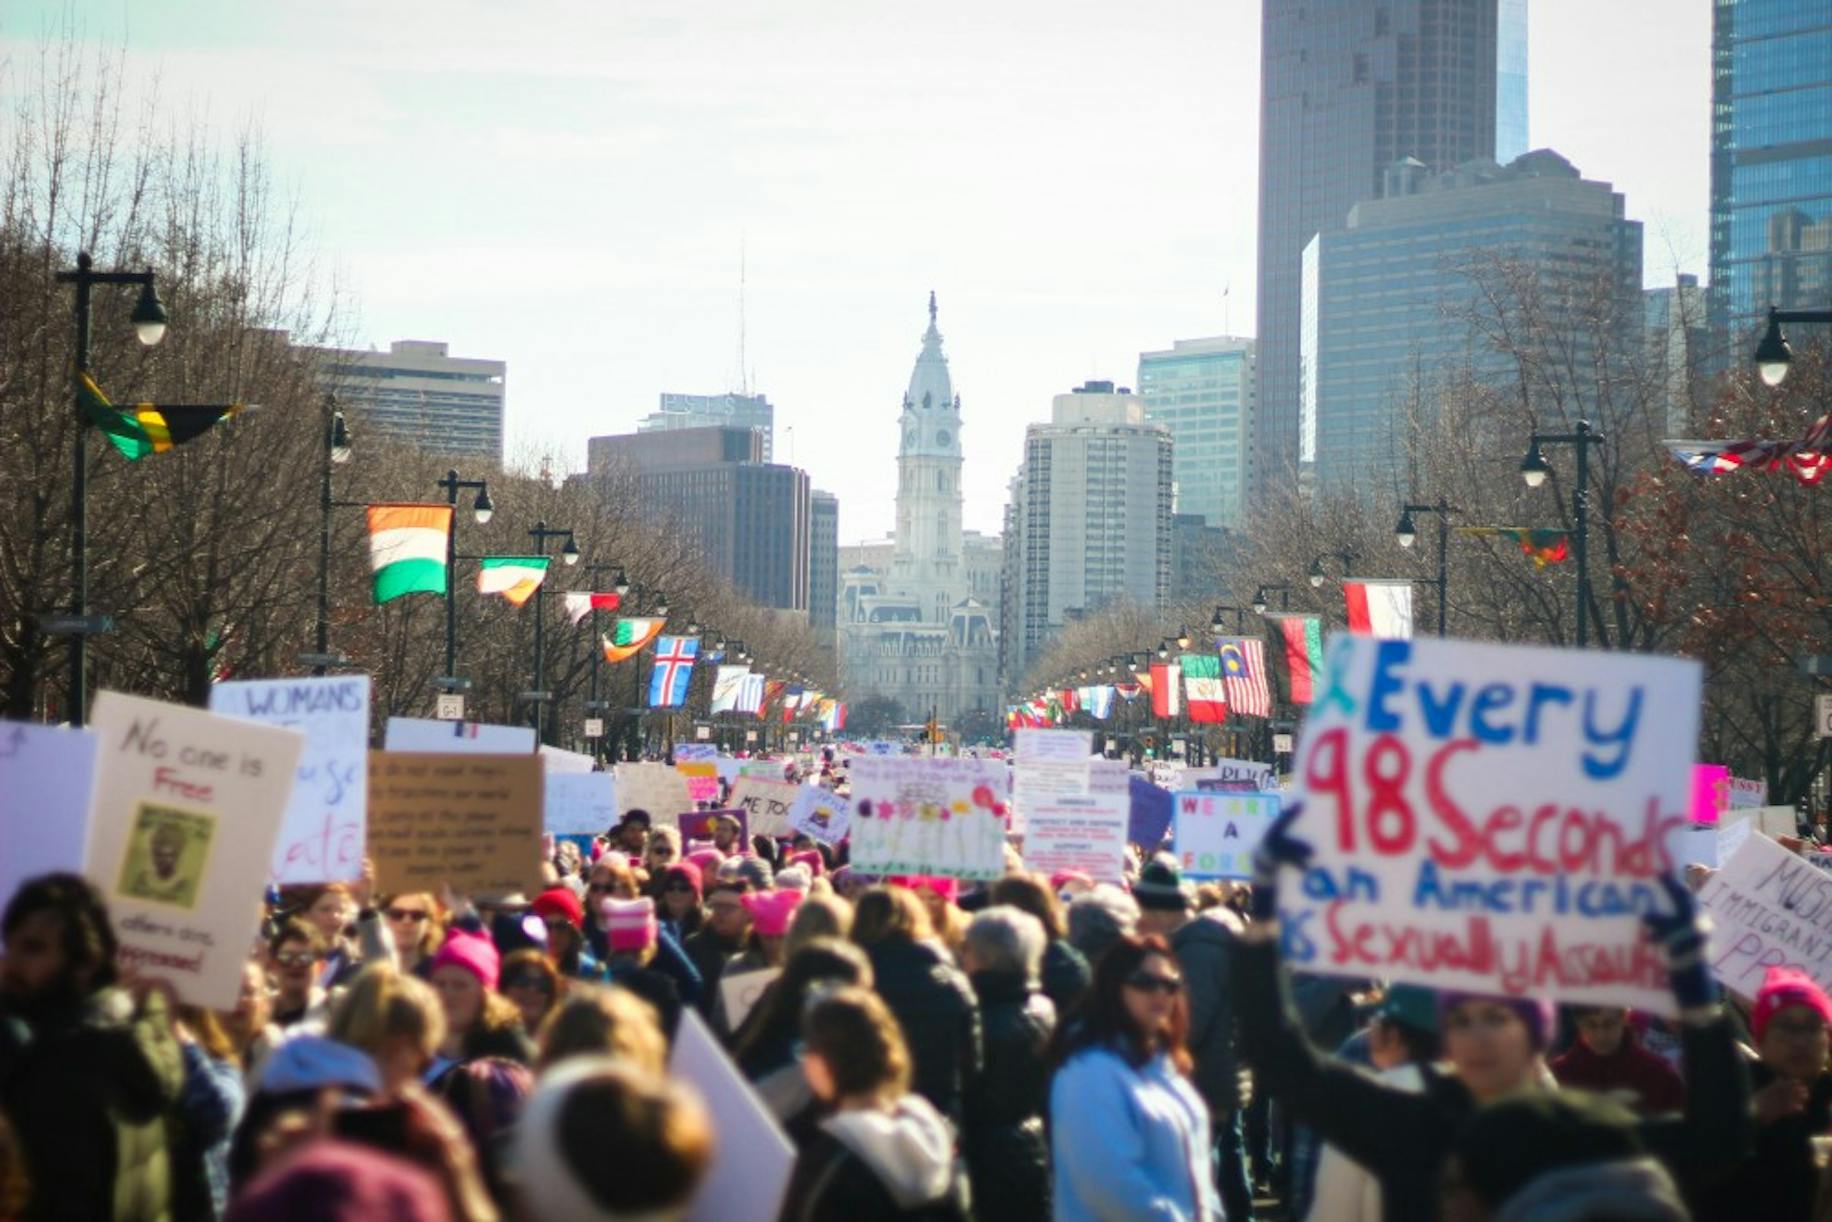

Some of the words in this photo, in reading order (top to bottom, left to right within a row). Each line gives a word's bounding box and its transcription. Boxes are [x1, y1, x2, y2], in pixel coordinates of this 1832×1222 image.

[1364, 638, 1645, 781] Every
[120, 716, 168, 759] No
[179, 746, 230, 770] one
[239, 751, 263, 776] is
[153, 766, 214, 802] Free
[740, 796, 761, 813] ME
[1306, 726, 1416, 857] 98
[1223, 820, 1238, 839] A
[1182, 851, 1252, 876] FORC
[1303, 863, 1380, 904] an
[1412, 859, 1658, 919] American
